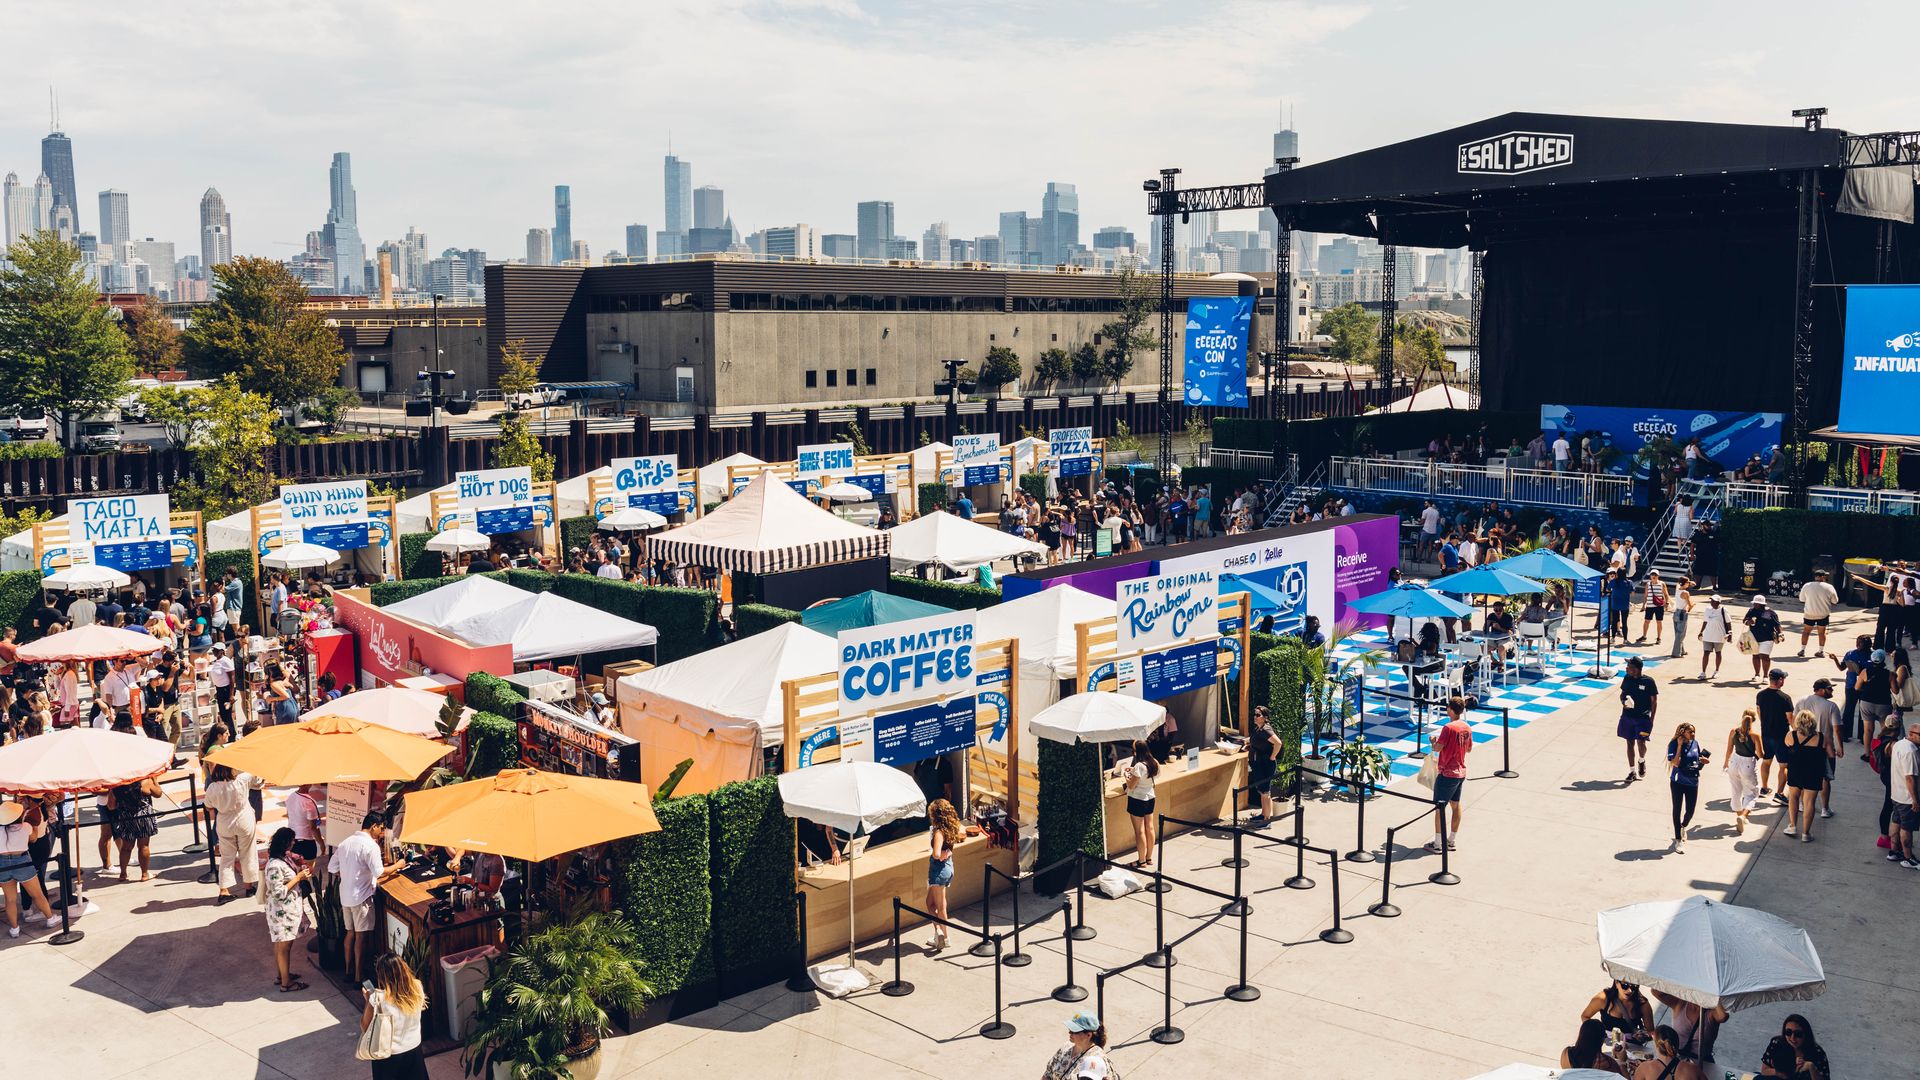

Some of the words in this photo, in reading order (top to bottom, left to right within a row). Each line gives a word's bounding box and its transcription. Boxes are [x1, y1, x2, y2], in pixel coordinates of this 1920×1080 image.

[1205, 350, 1225, 363] CON
[954, 437, 980, 446] DOVE'S
[1051, 429, 1090, 442] PROFESSOR
[1051, 442, 1090, 456] PIZZA
[634, 459, 654, 470] DR.
[460, 474, 479, 483] THE
[616, 460, 674, 490] Bird's
[326, 486, 364, 501] KHAO
[460, 481, 494, 498] HOT
[499, 478, 528, 494] DOG
[514, 493, 528, 501] BOX
[76, 498, 136, 520] TACO
[291, 504, 318, 518] EAT
[323, 502, 358, 516] RICE
[84, 516, 160, 540] MAFIA
[1224, 555, 1248, 568] CHASE
[1264, 548, 1283, 562] Zelle
[1337, 552, 1368, 568] Receive
[1124, 581, 1150, 596] THE
[1157, 572, 1213, 590] ORIGINAL
[1123, 588, 1192, 638] Rainbow
[1172, 596, 1213, 638] Cone
[843, 638, 896, 662] DARK
[900, 624, 973, 653] MATTER
[843, 645, 973, 701] COFFEE
[1097, 665, 1110, 677] HERE
[984, 694, 998, 702] PICK
[998, 697, 1006, 707] UP
[532, 708, 562, 736] MONKEY
[564, 724, 608, 753] SHOULDER
[802, 744, 813, 768] RDER
[813, 730, 831, 744] HERE
